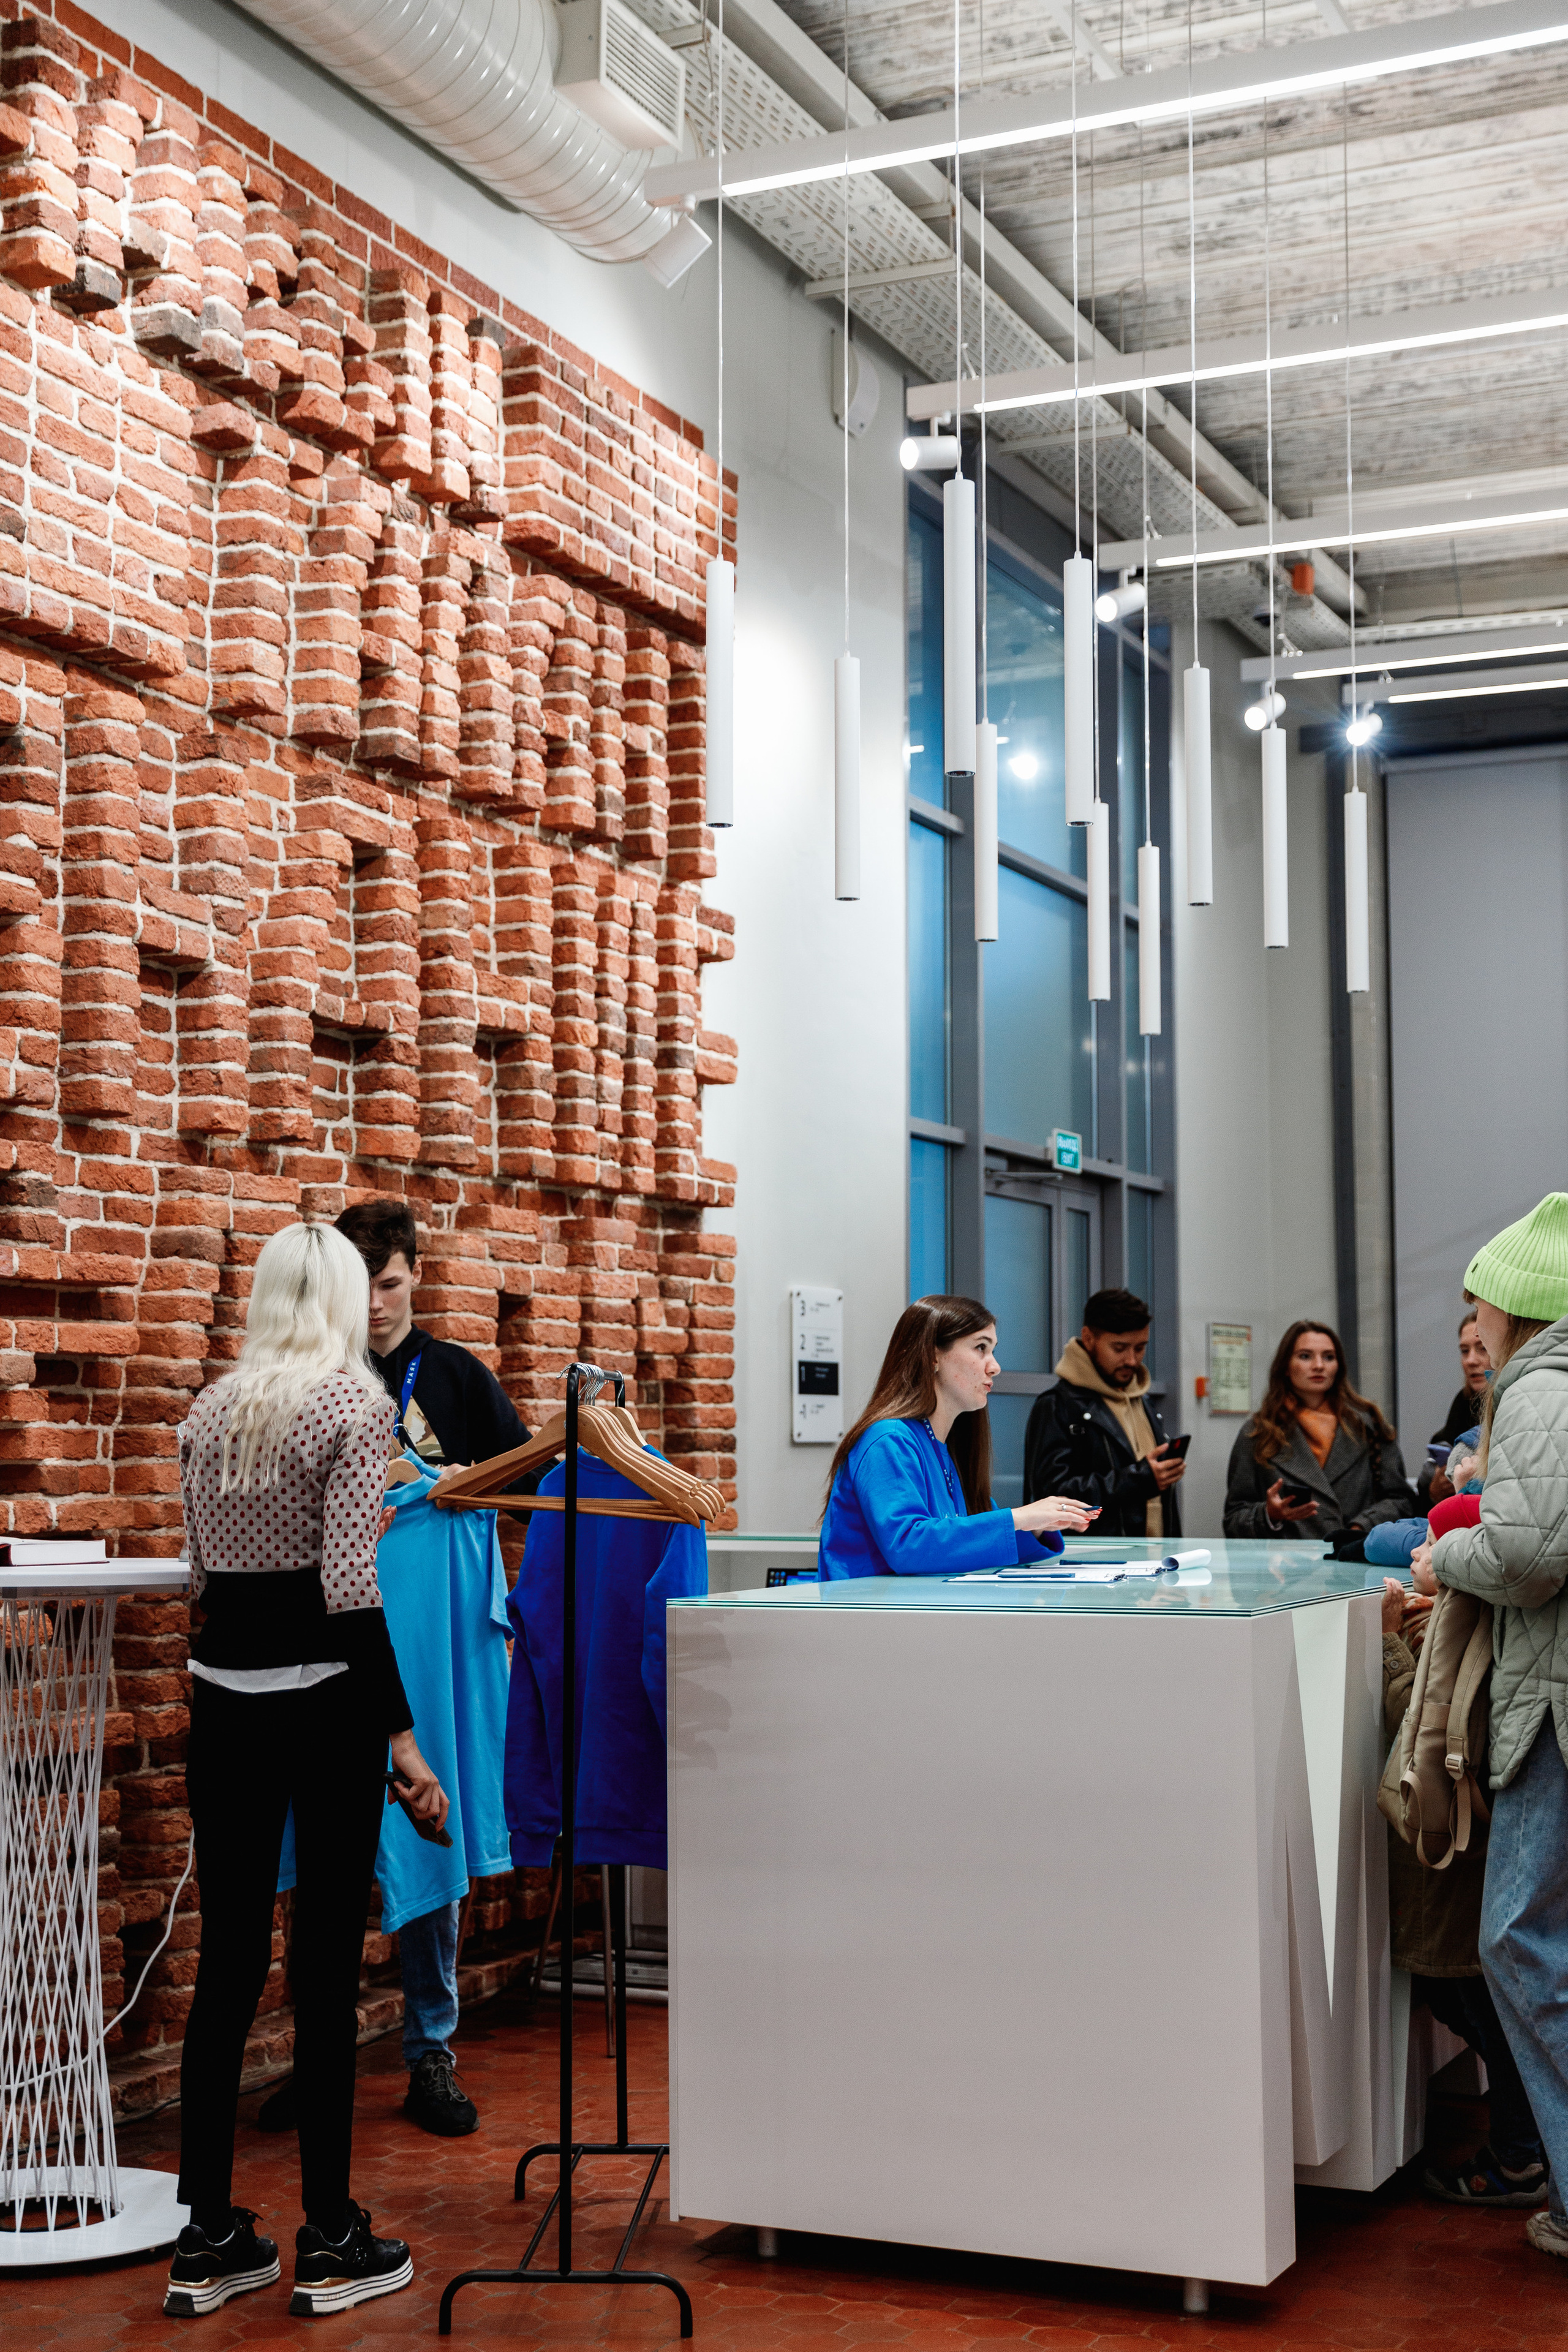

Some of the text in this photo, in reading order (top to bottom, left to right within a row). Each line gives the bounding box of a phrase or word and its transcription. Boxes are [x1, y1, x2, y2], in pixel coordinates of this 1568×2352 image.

[801, 1300, 806, 1316] 3
[800, 1333, 806, 1351] 2
[800, 1366, 805, 1382] 1
